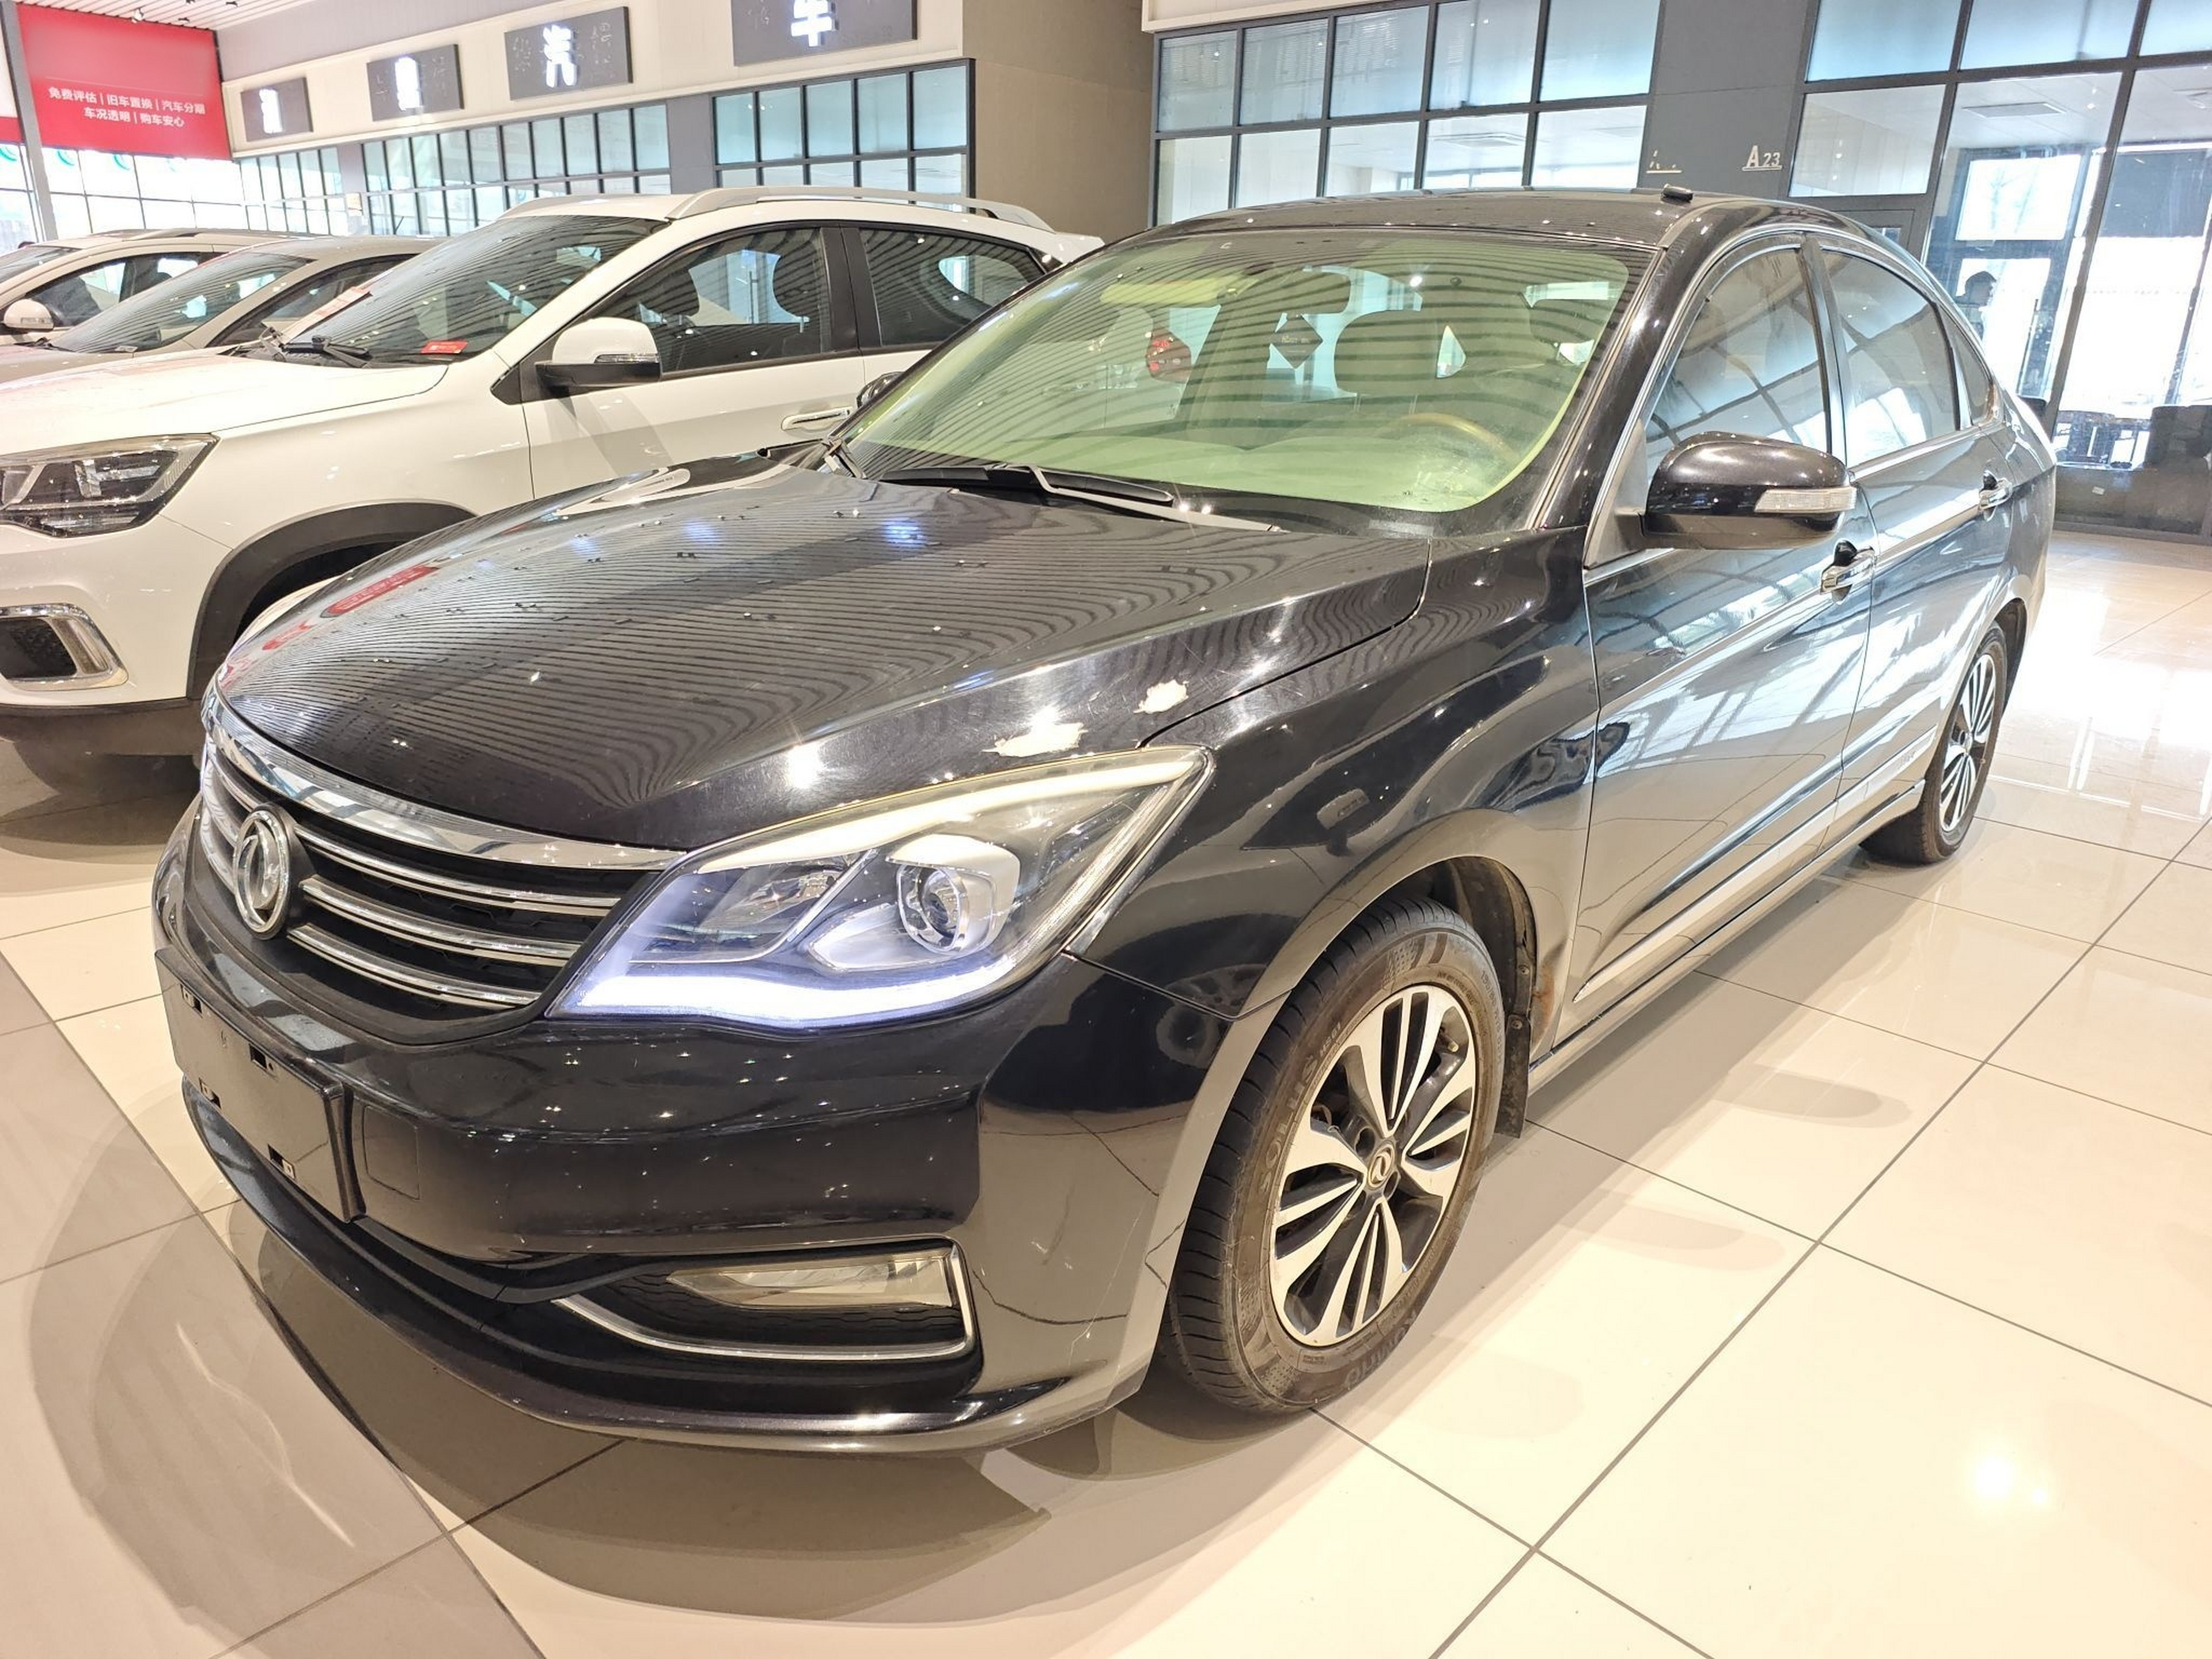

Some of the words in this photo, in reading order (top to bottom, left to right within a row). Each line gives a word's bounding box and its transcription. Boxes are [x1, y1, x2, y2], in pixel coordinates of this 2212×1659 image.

[48, 86, 97, 104] 免费评估
[107, 94, 153, 110] 旧车置换
[161, 99, 206, 115] 汽车分期
[84, 107, 131, 123] 车况透明
[139, 112, 185, 127] 购车安心
[1260, 1054, 1319, 1193] SOLUS
